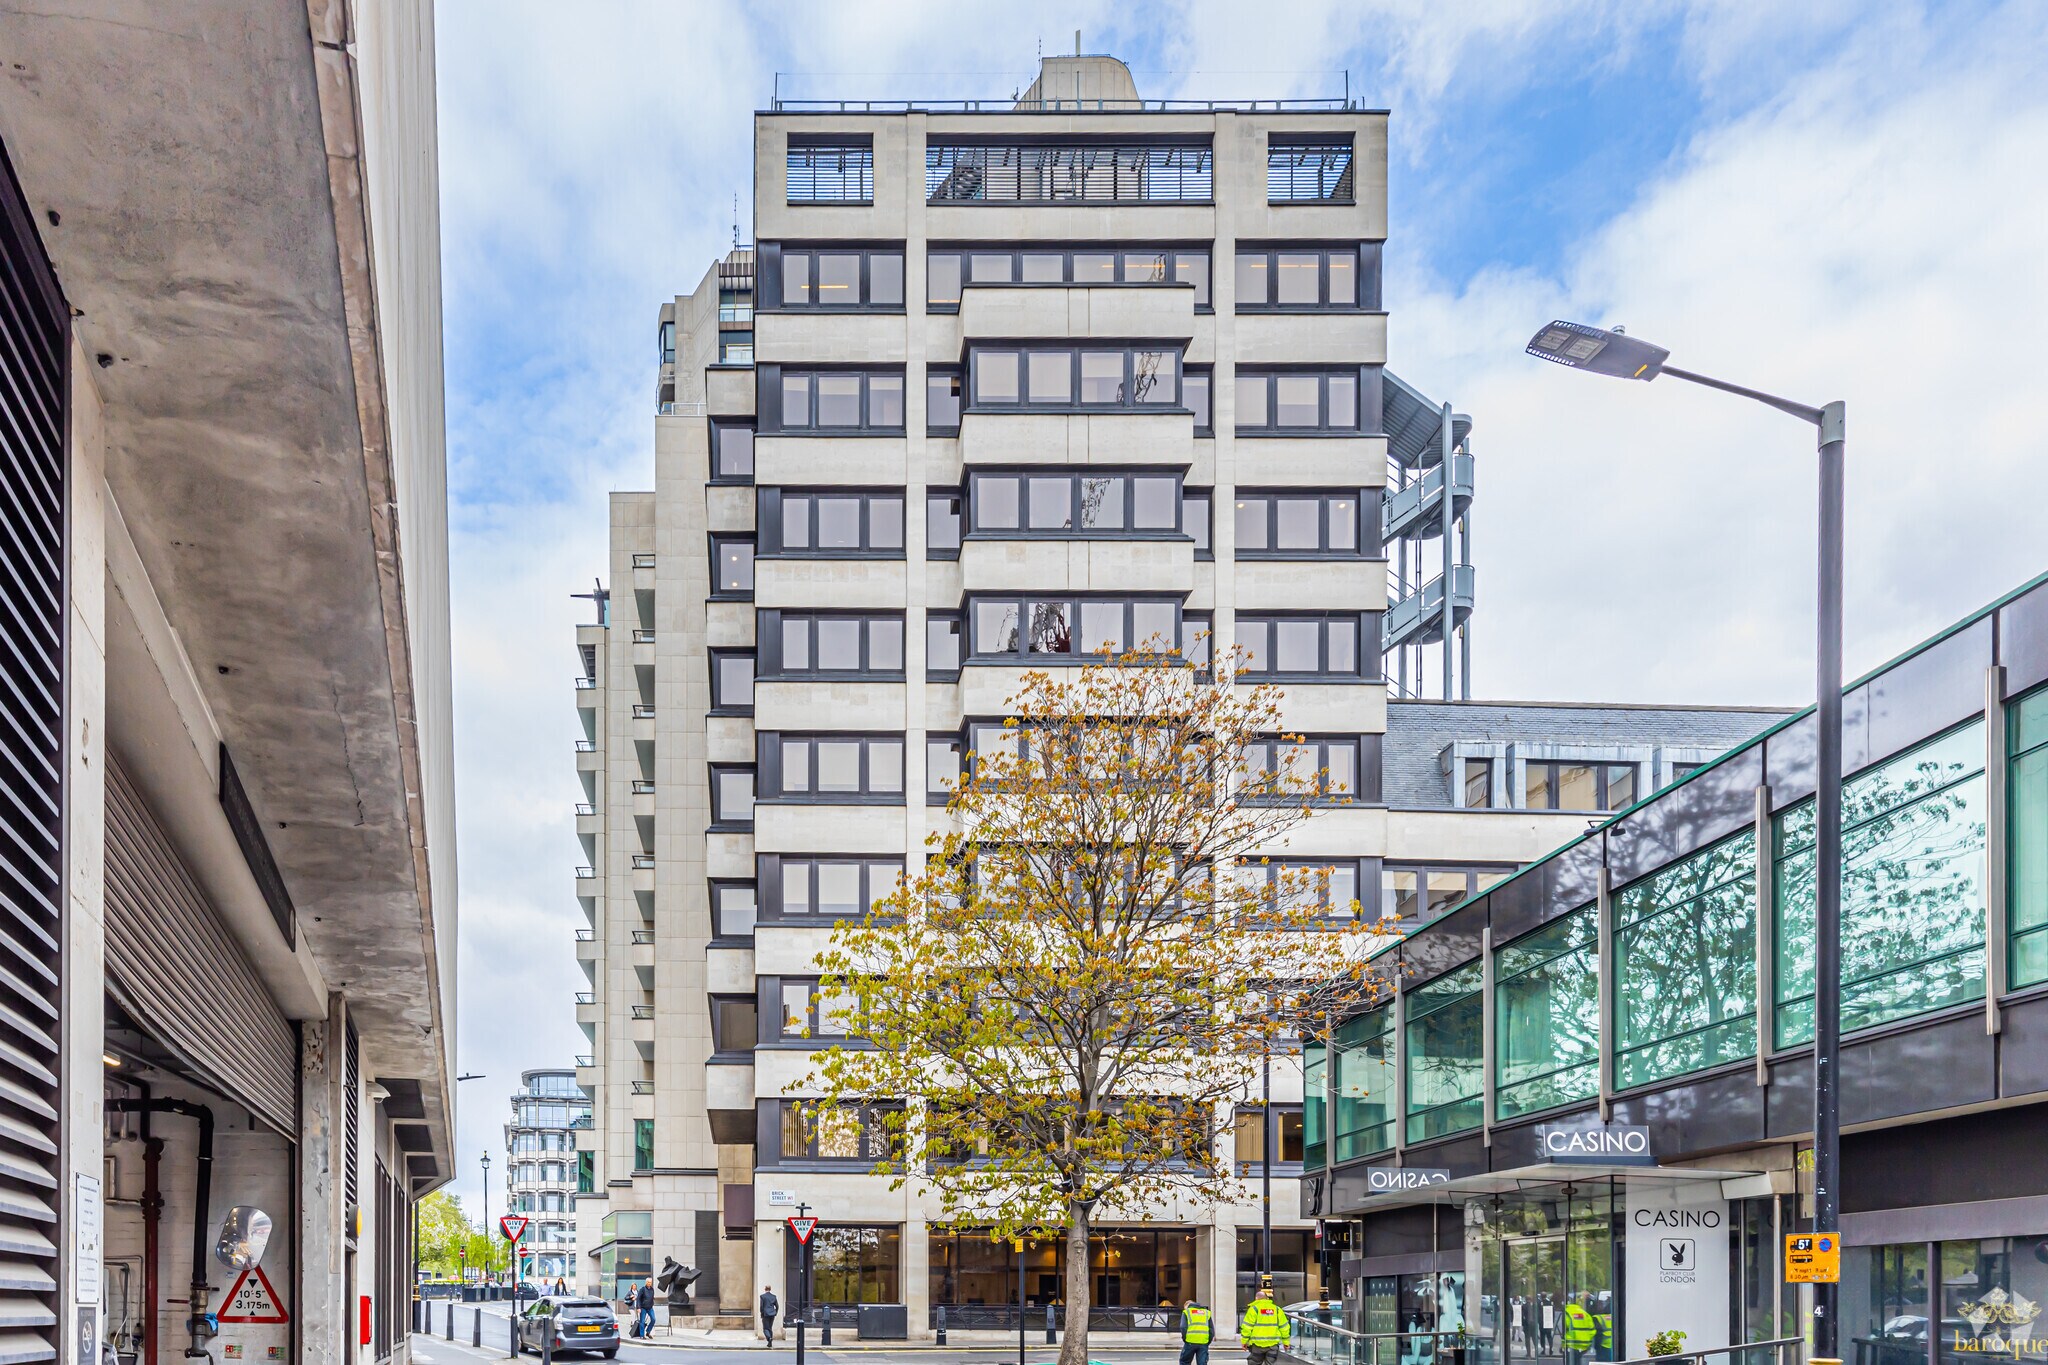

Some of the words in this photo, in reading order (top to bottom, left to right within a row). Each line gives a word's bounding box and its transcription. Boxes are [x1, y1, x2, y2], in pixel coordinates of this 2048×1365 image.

[1547, 1131, 1646, 1152] CASINO
[1634, 1209, 1721, 1228] CASINO
[1798, 1239, 1810, 1250] 5T
[235, 1300, 270, 1309] 3.175m
[1953, 1329, 2048, 1361] baroque
